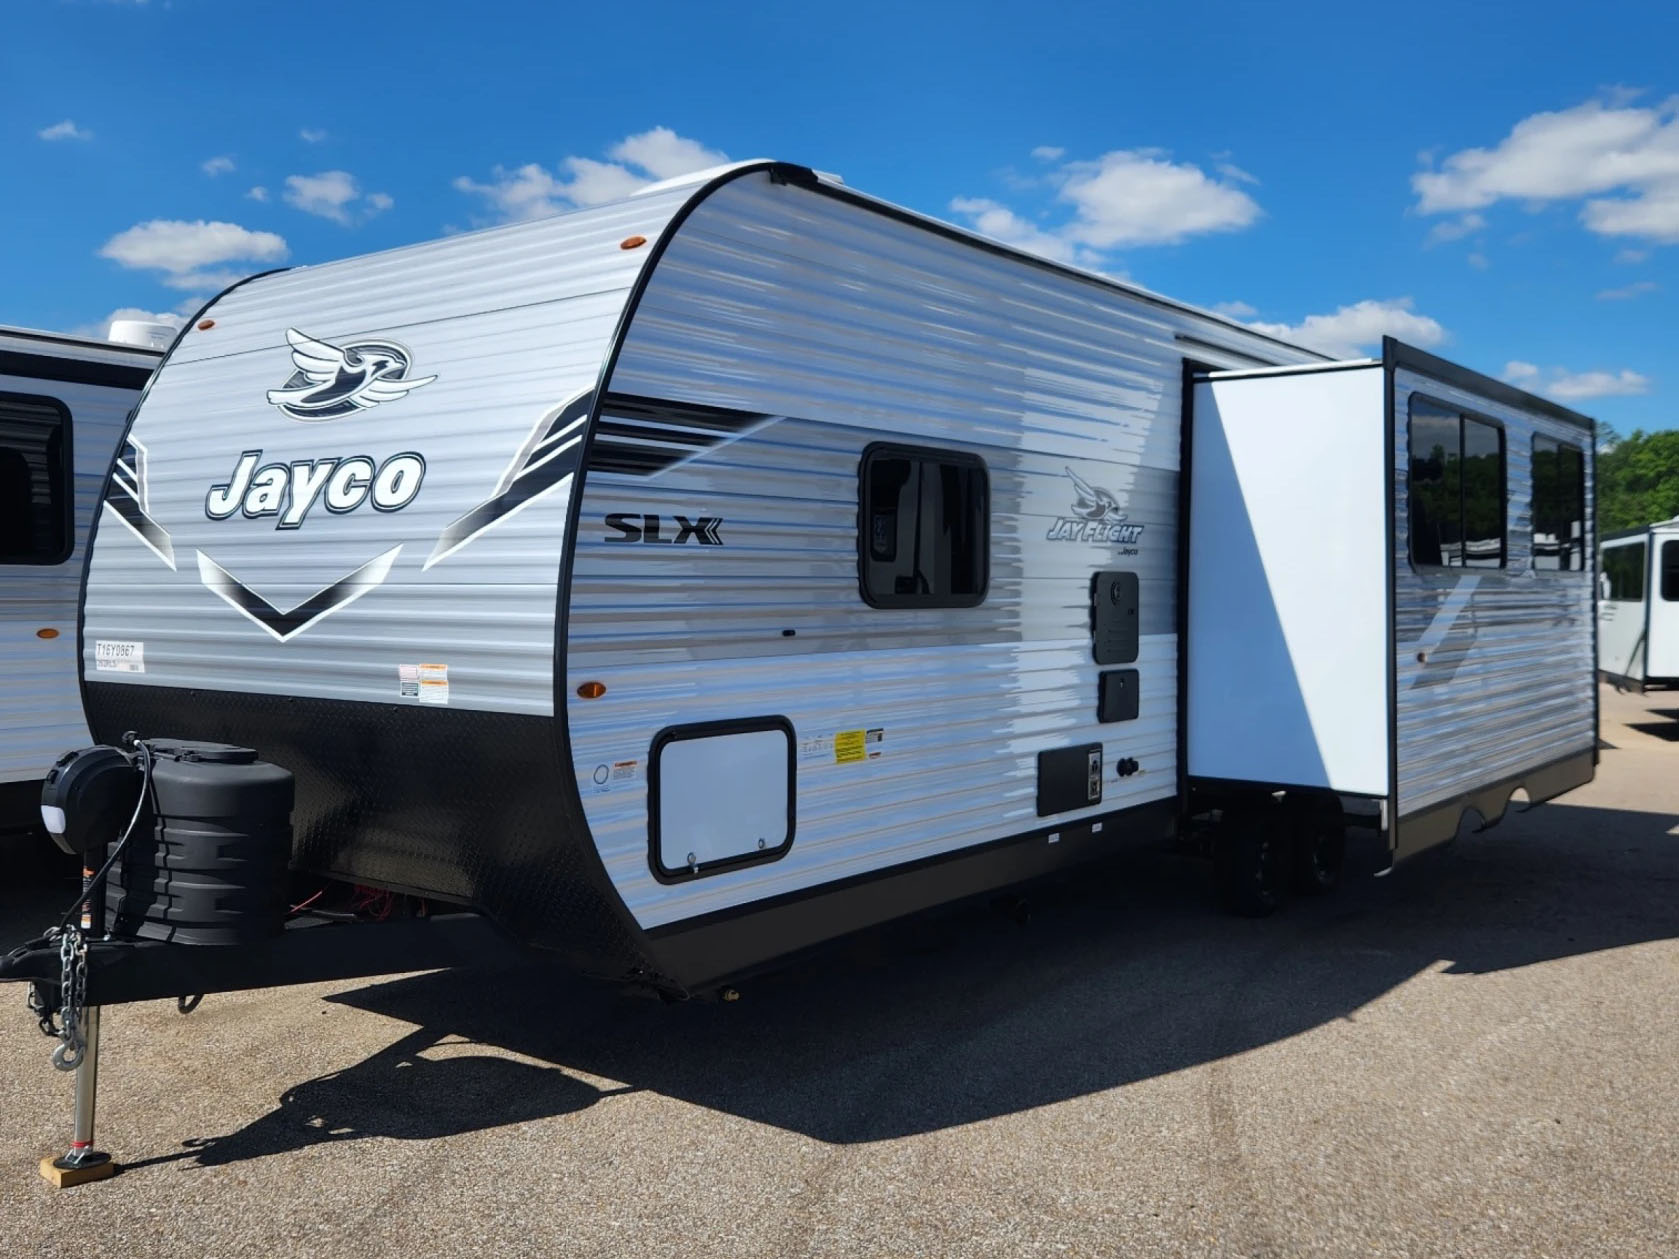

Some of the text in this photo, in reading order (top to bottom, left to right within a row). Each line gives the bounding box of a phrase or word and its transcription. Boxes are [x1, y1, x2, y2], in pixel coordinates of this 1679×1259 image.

[205, 449, 426, 530] Jayco
[604, 513, 724, 545] SLX
[1046, 517, 1144, 543] JAY FLIGHT
